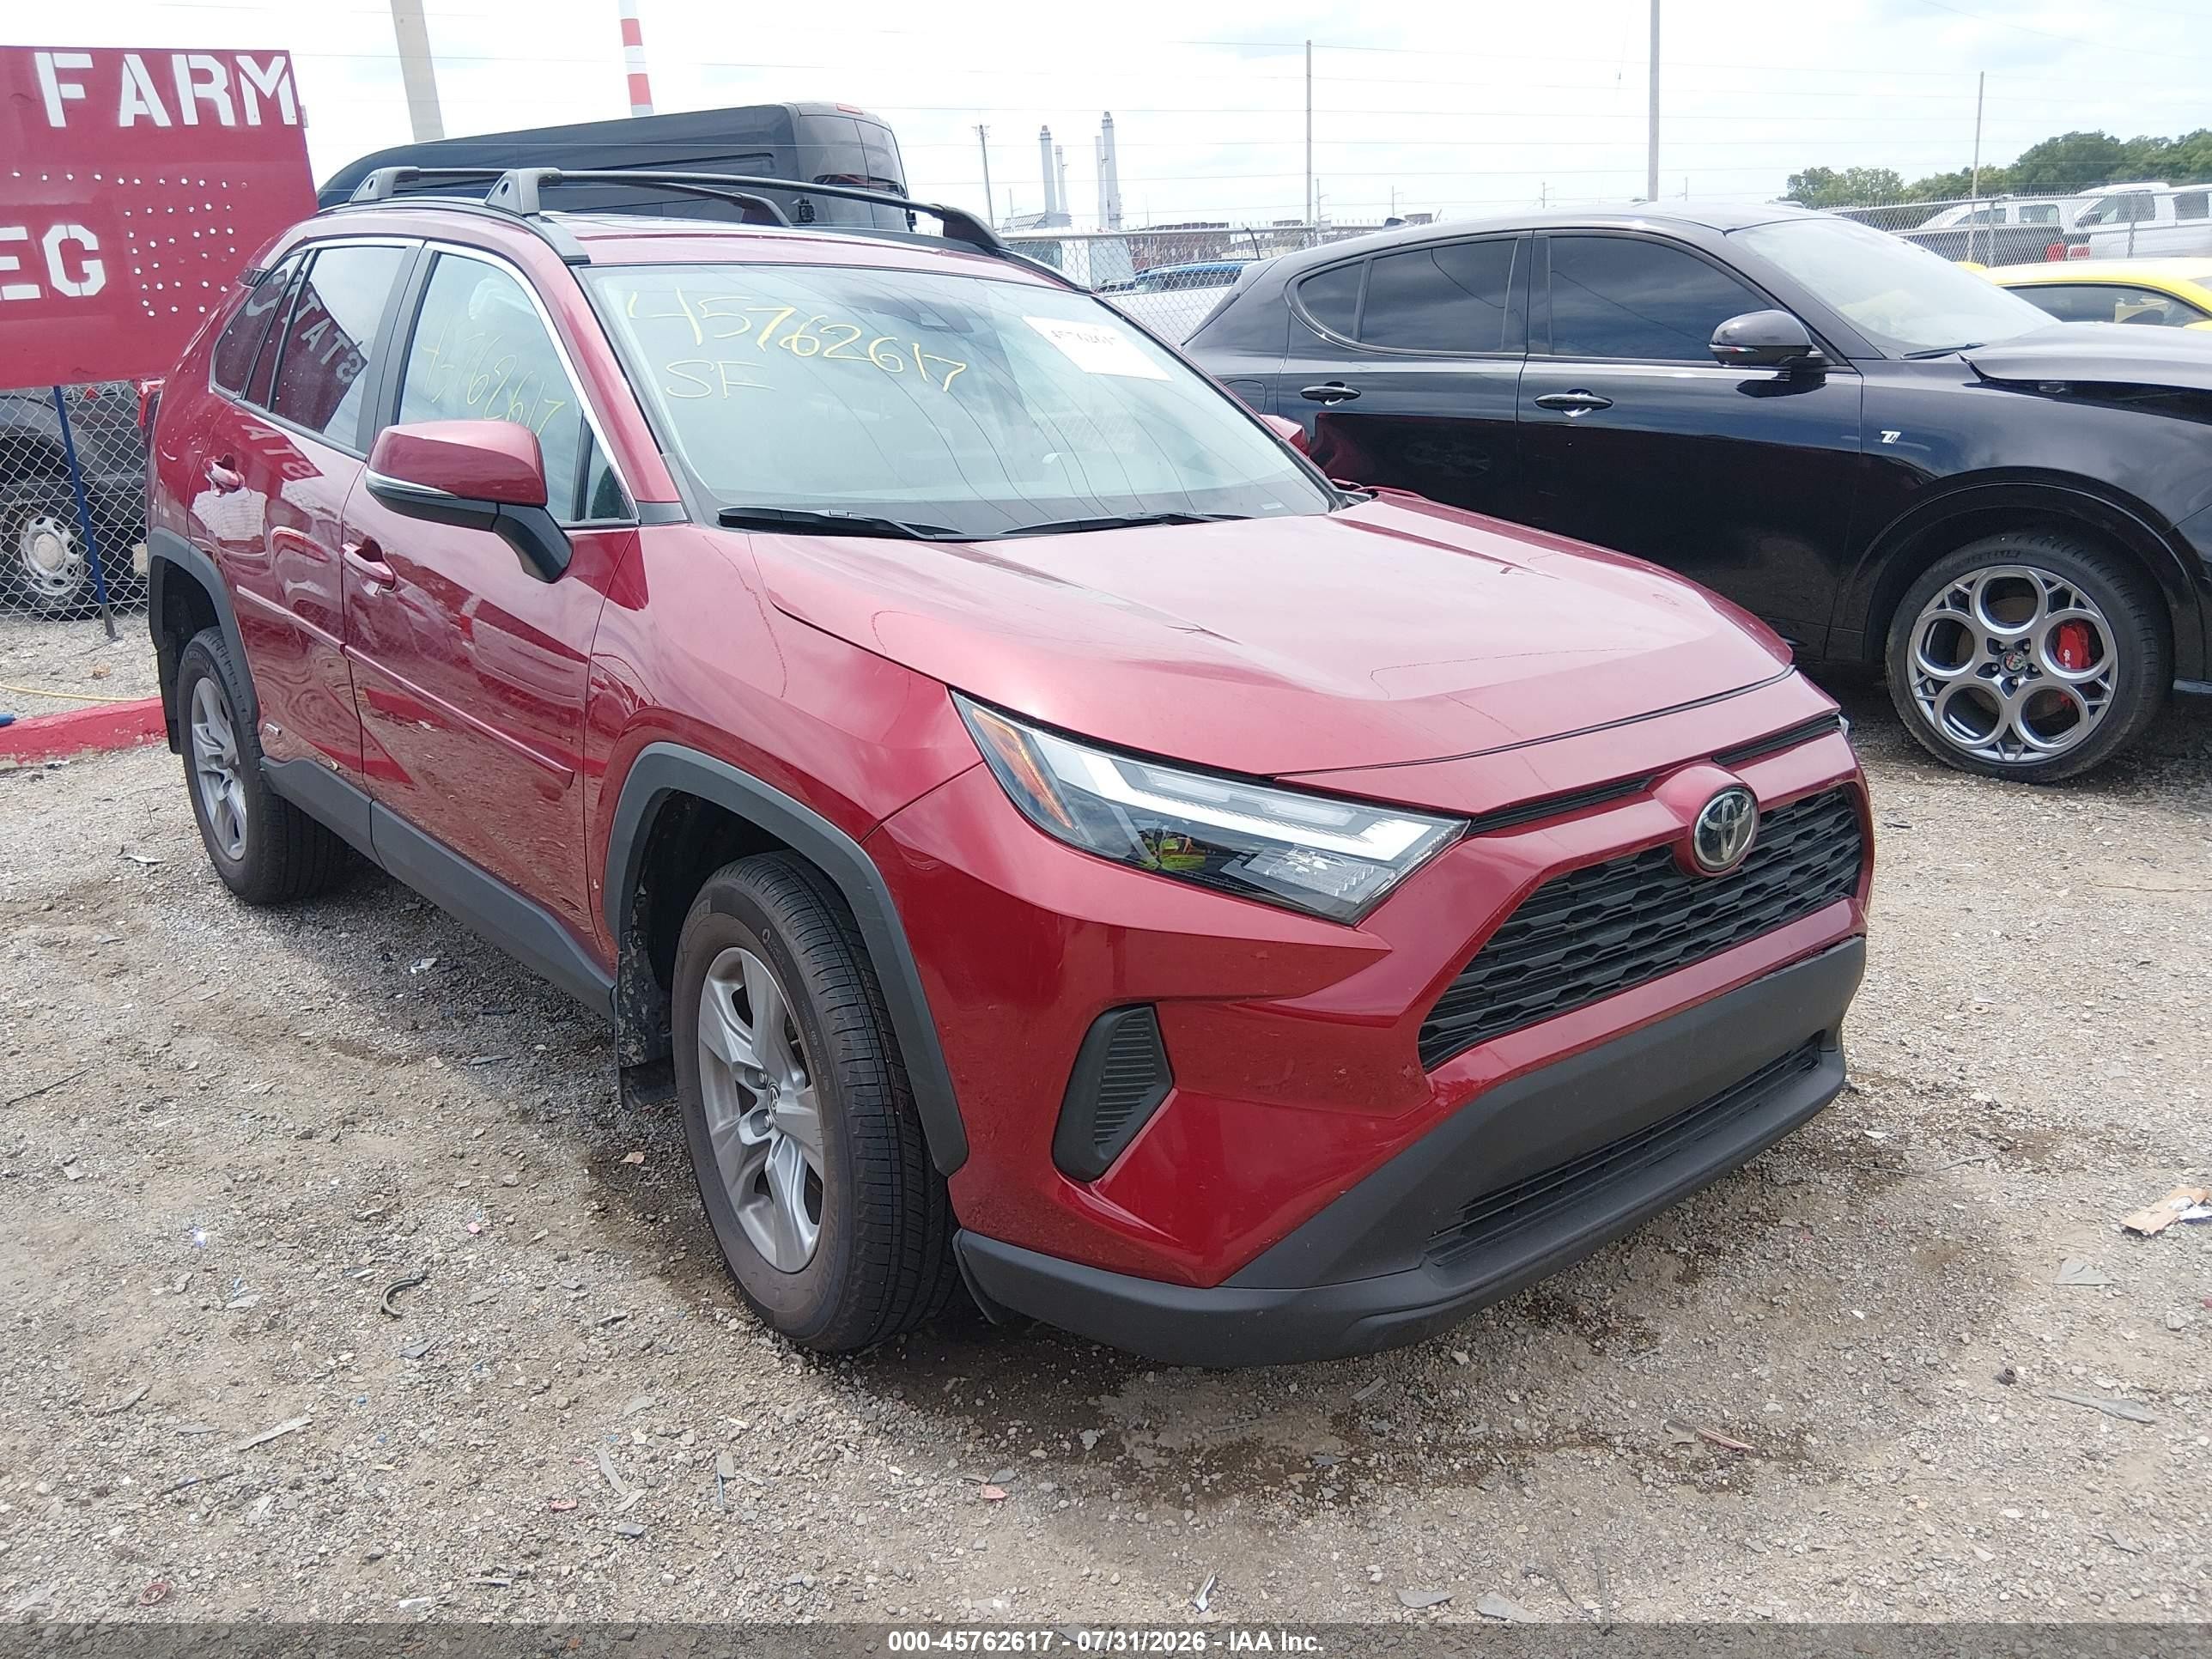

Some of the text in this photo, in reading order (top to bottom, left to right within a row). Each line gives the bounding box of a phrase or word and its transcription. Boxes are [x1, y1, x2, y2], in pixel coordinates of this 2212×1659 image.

[34, 52, 298, 128] FARM
[628, 288, 967, 392] 45762617
[665, 359, 776, 399] SF
